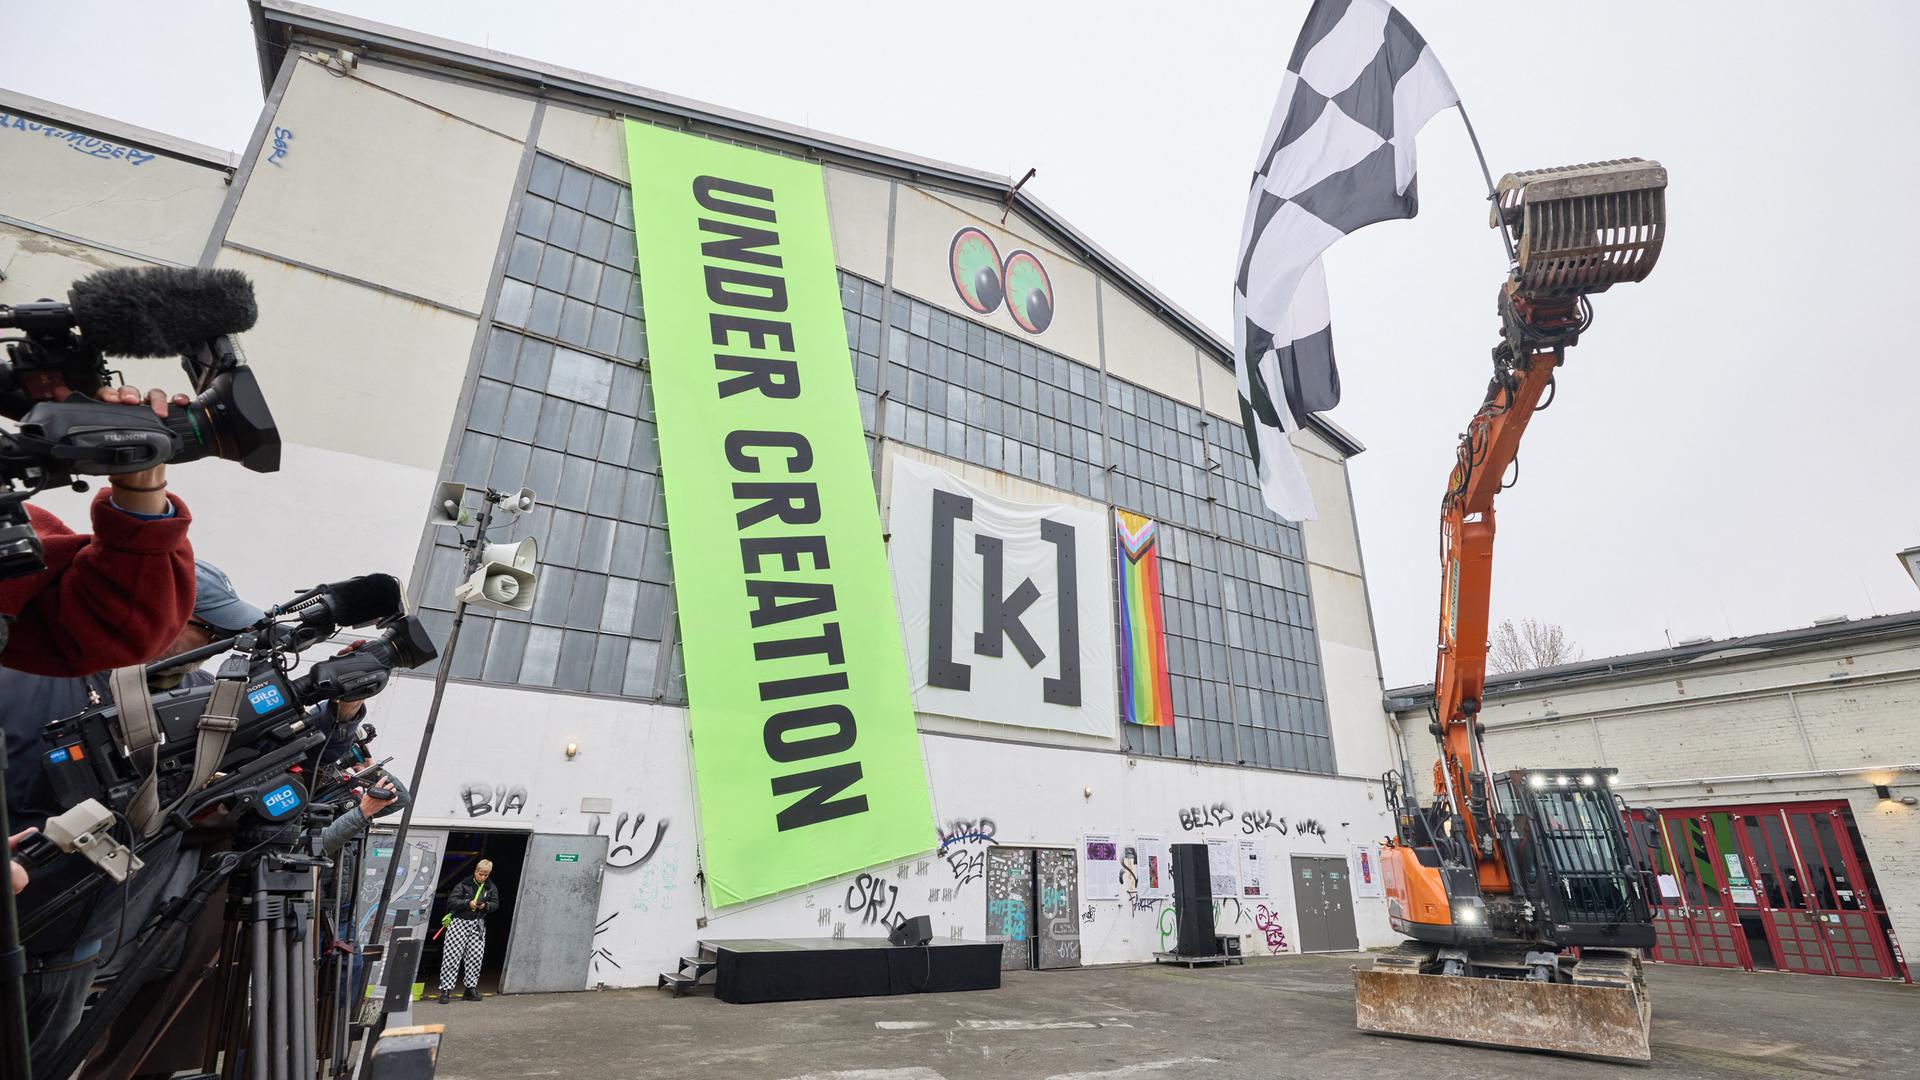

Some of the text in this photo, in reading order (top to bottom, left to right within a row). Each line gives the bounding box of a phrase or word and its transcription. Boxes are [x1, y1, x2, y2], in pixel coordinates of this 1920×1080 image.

[692, 175, 869, 832] UNDER CREATION
[246, 681, 269, 693] SONY
[250, 690, 277, 704] dito
[266, 789, 292, 806] dito
[281, 797, 295, 808] tv
